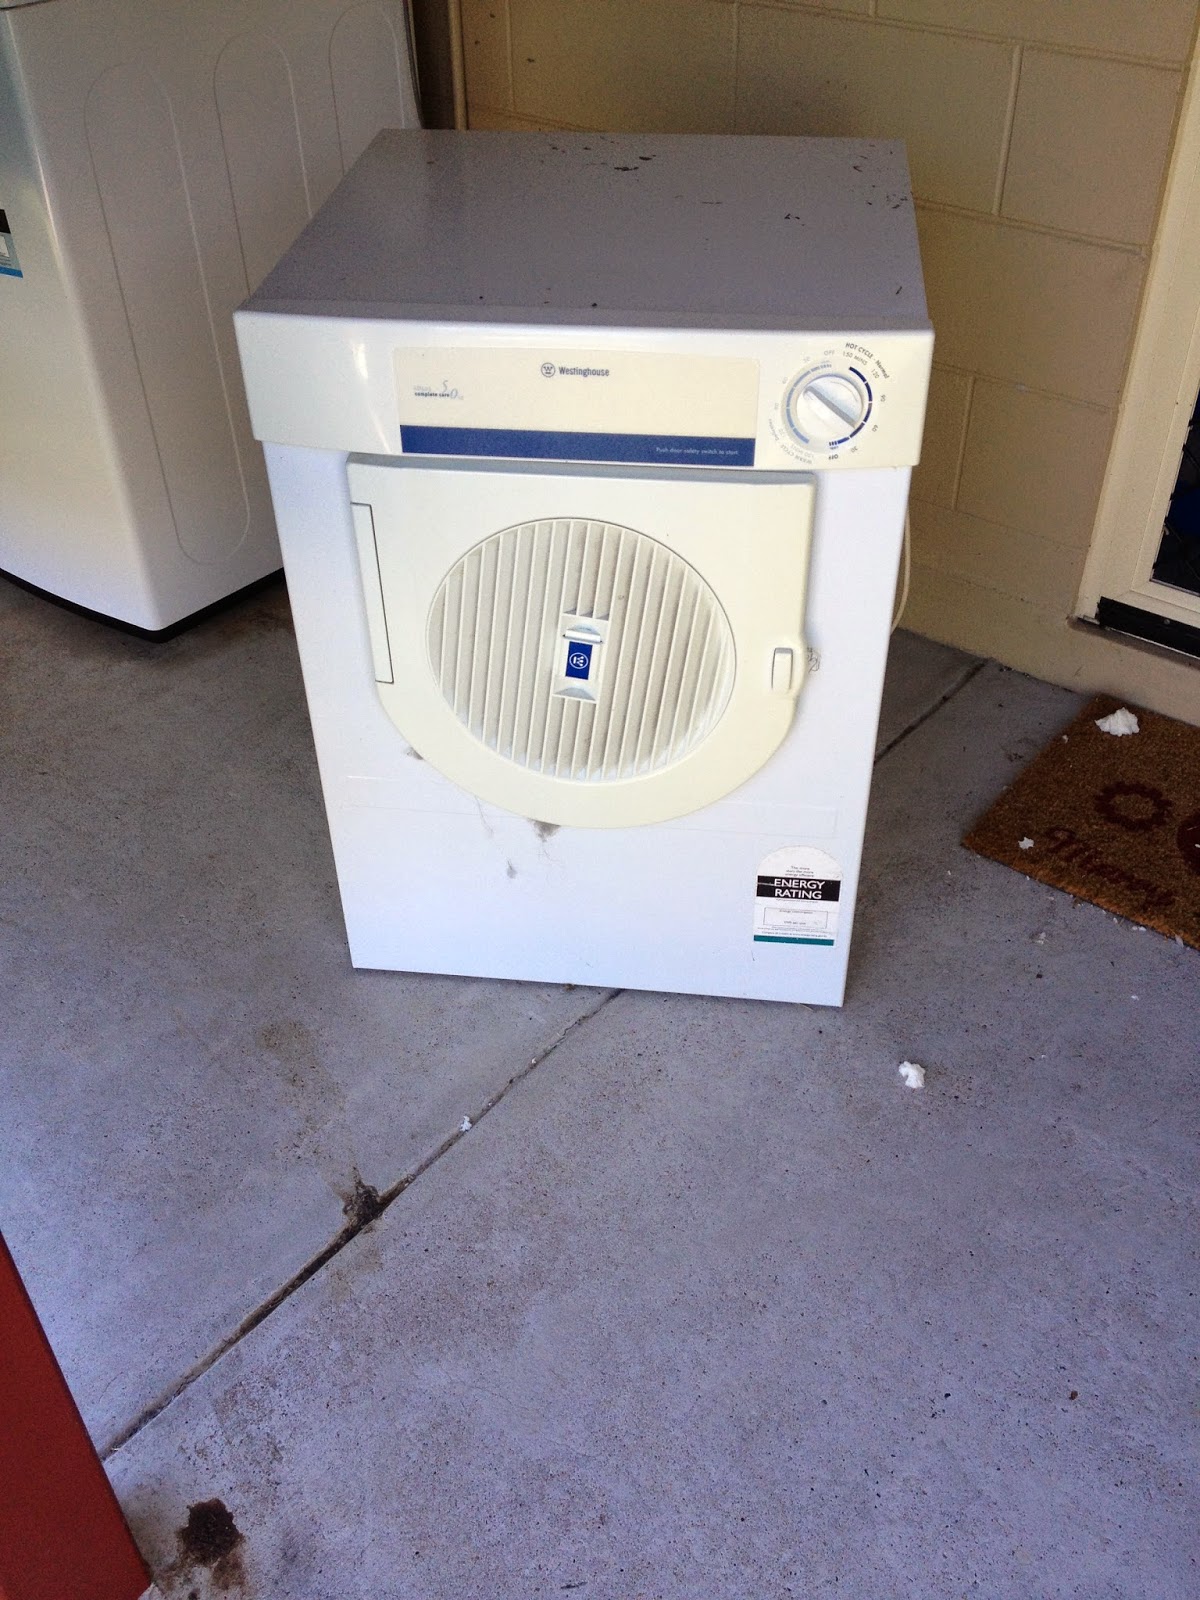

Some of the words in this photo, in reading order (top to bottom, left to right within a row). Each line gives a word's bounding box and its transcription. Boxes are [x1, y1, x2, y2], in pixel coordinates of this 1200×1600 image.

[845, 342, 858, 351] HOT
[858, 347, 873, 359] CYCLE
[875, 360, 890, 379] Normal
[558, 366, 610, 377] Westinghouse
[774, 878, 826, 890] ENERGY
[774, 888, 822, 900] RATING
